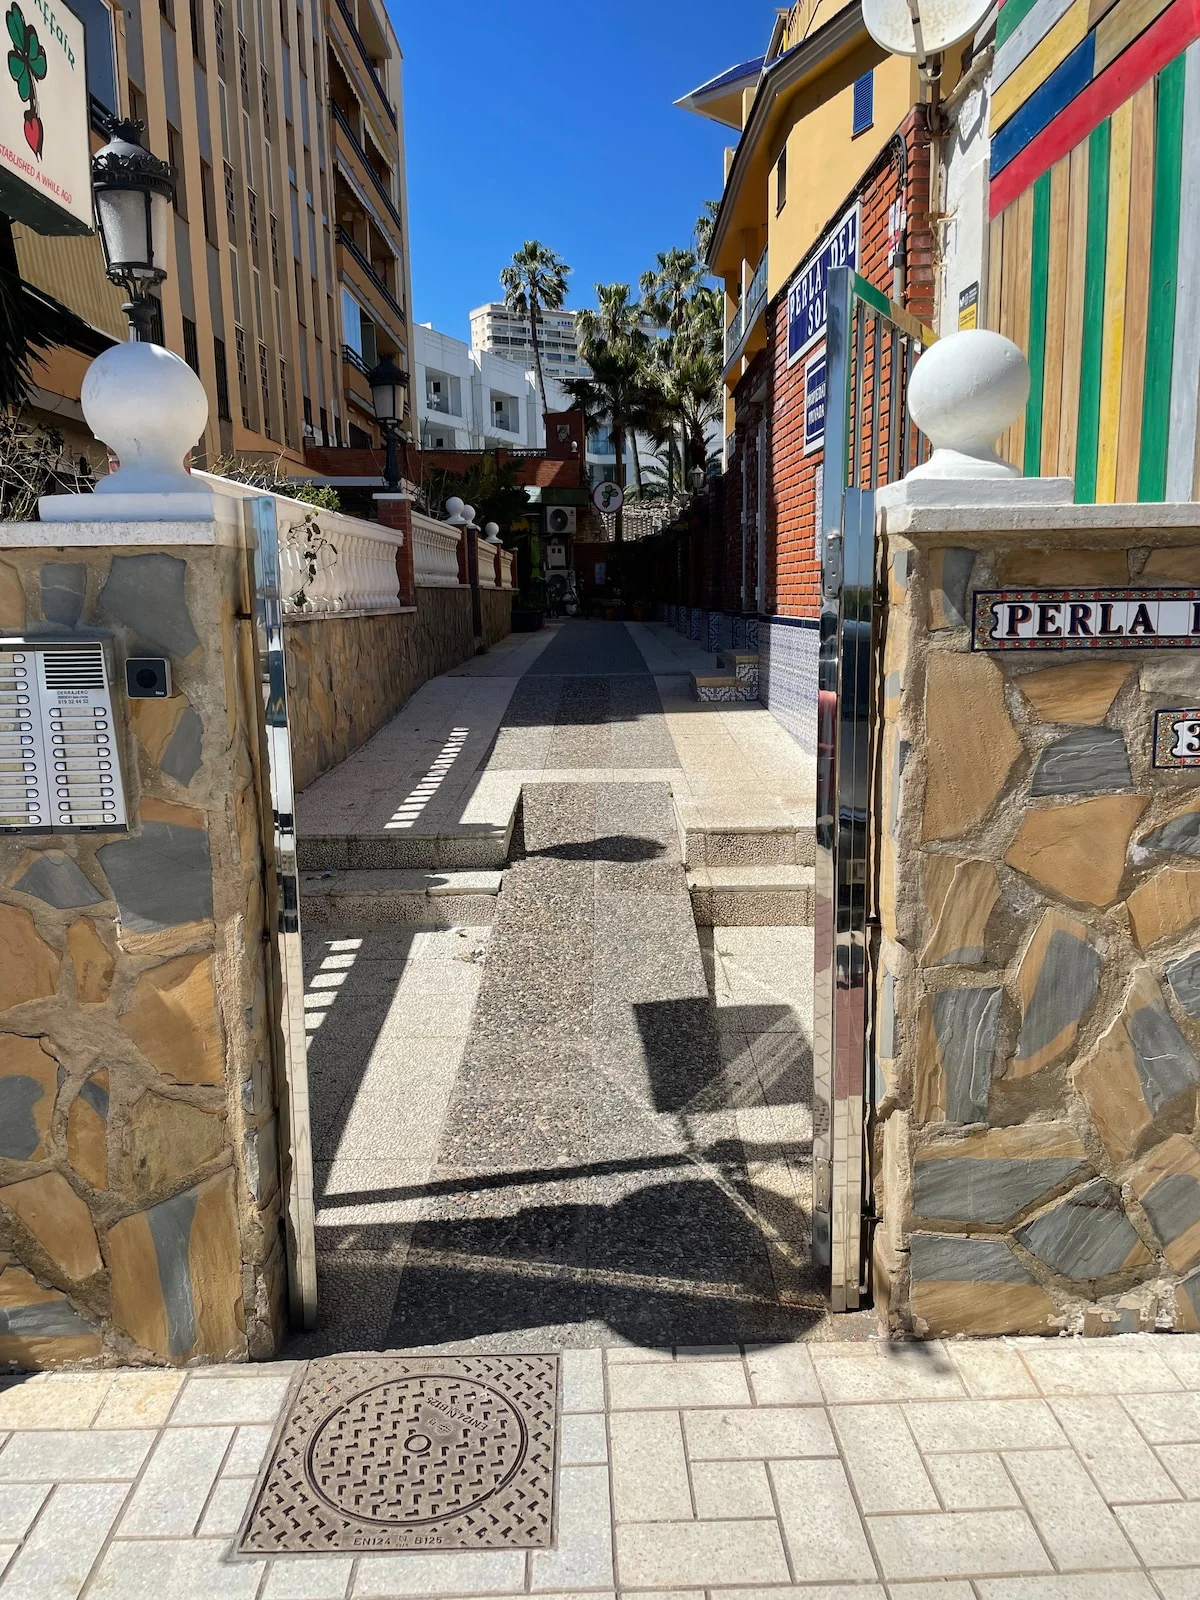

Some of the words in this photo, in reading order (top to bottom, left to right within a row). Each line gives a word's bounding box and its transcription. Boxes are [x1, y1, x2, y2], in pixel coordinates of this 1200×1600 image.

[36, 171, 41, 181] A
[42, 175, 60, 196] WHILE
[61, 189, 73, 204] AGO
[789, 260, 821, 324] PERLA
[831, 218, 855, 267] DEL
[808, 289, 827, 336] SOL
[1005, 602, 1156, 637] PERLA
[425, 1396, 449, 1412] B125
[457, 1412, 489, 1431] EN124
[353, 1537, 391, 1546] EN124
[414, 1536, 443, 1544] B125
